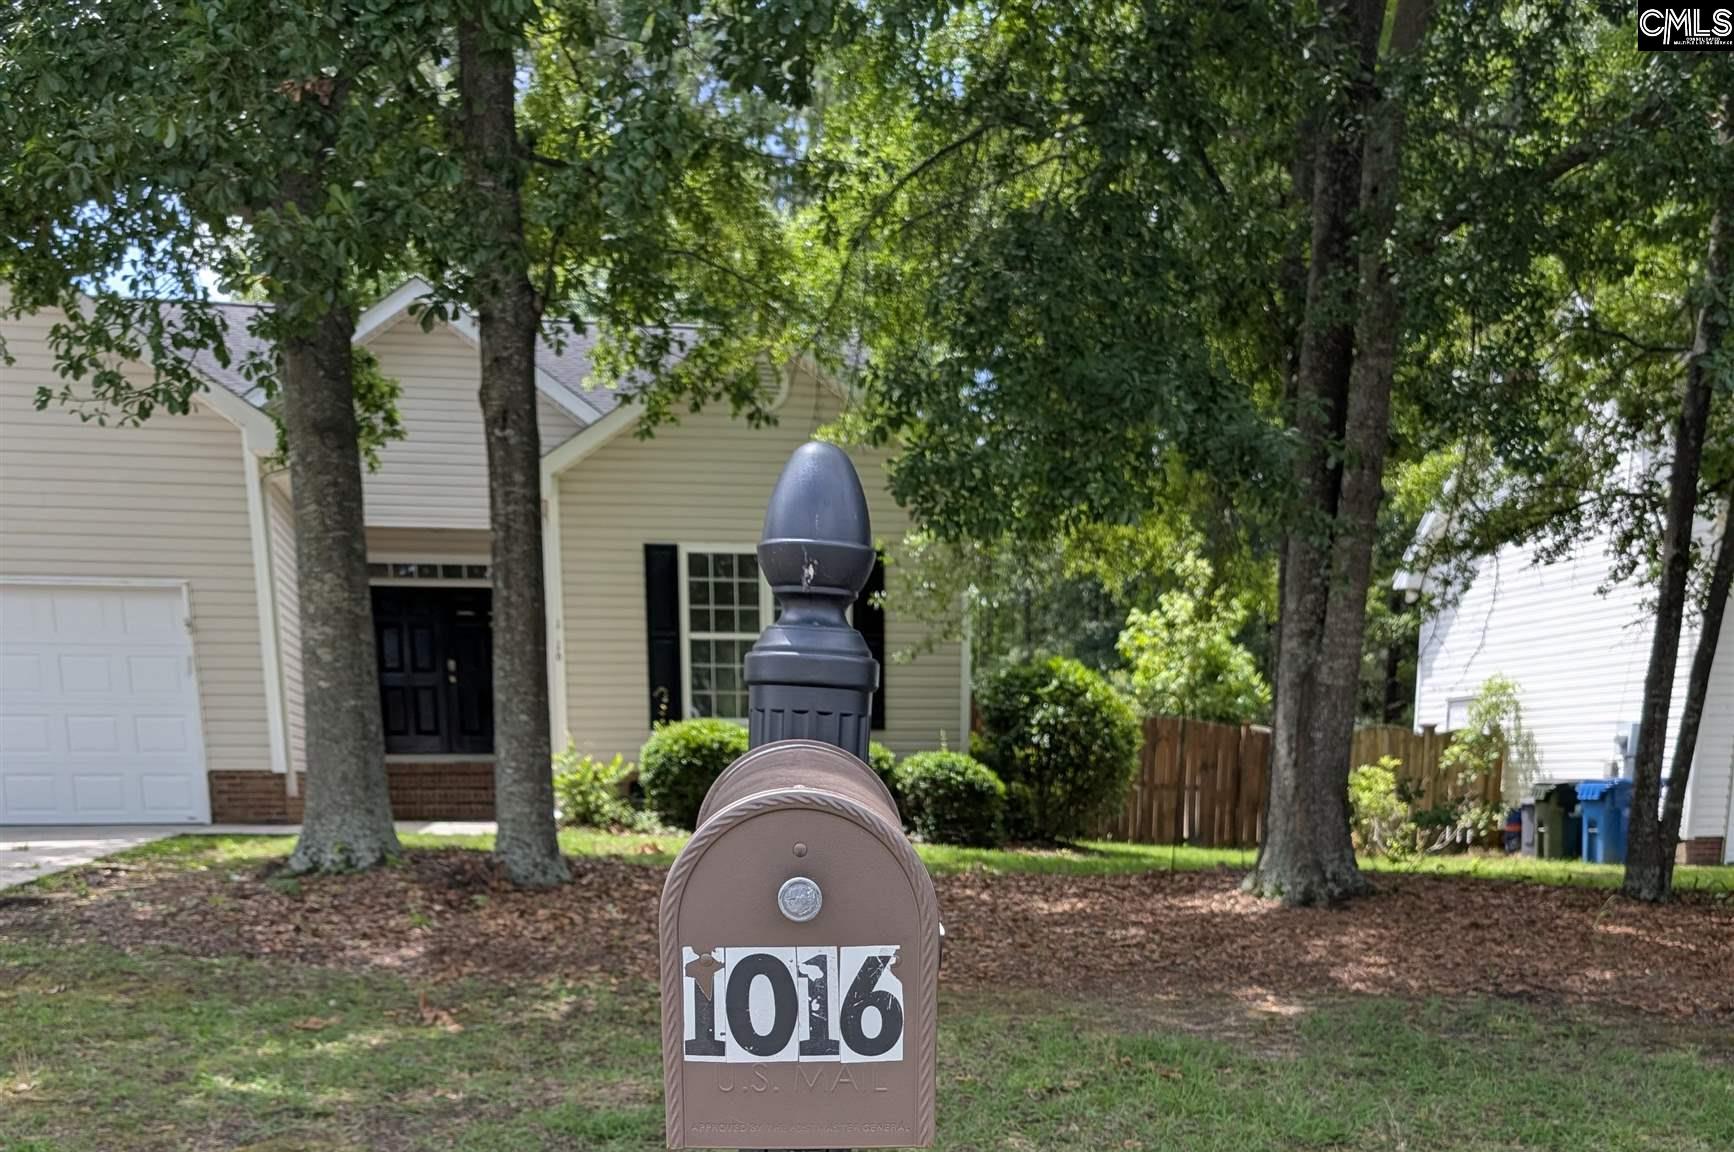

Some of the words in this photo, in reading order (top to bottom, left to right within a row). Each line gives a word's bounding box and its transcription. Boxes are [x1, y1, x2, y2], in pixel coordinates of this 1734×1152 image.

[684, 952, 903, 1057] 1016
[714, 1063, 780, 1093] U.S.
[793, 1064, 889, 1093] MAIL
